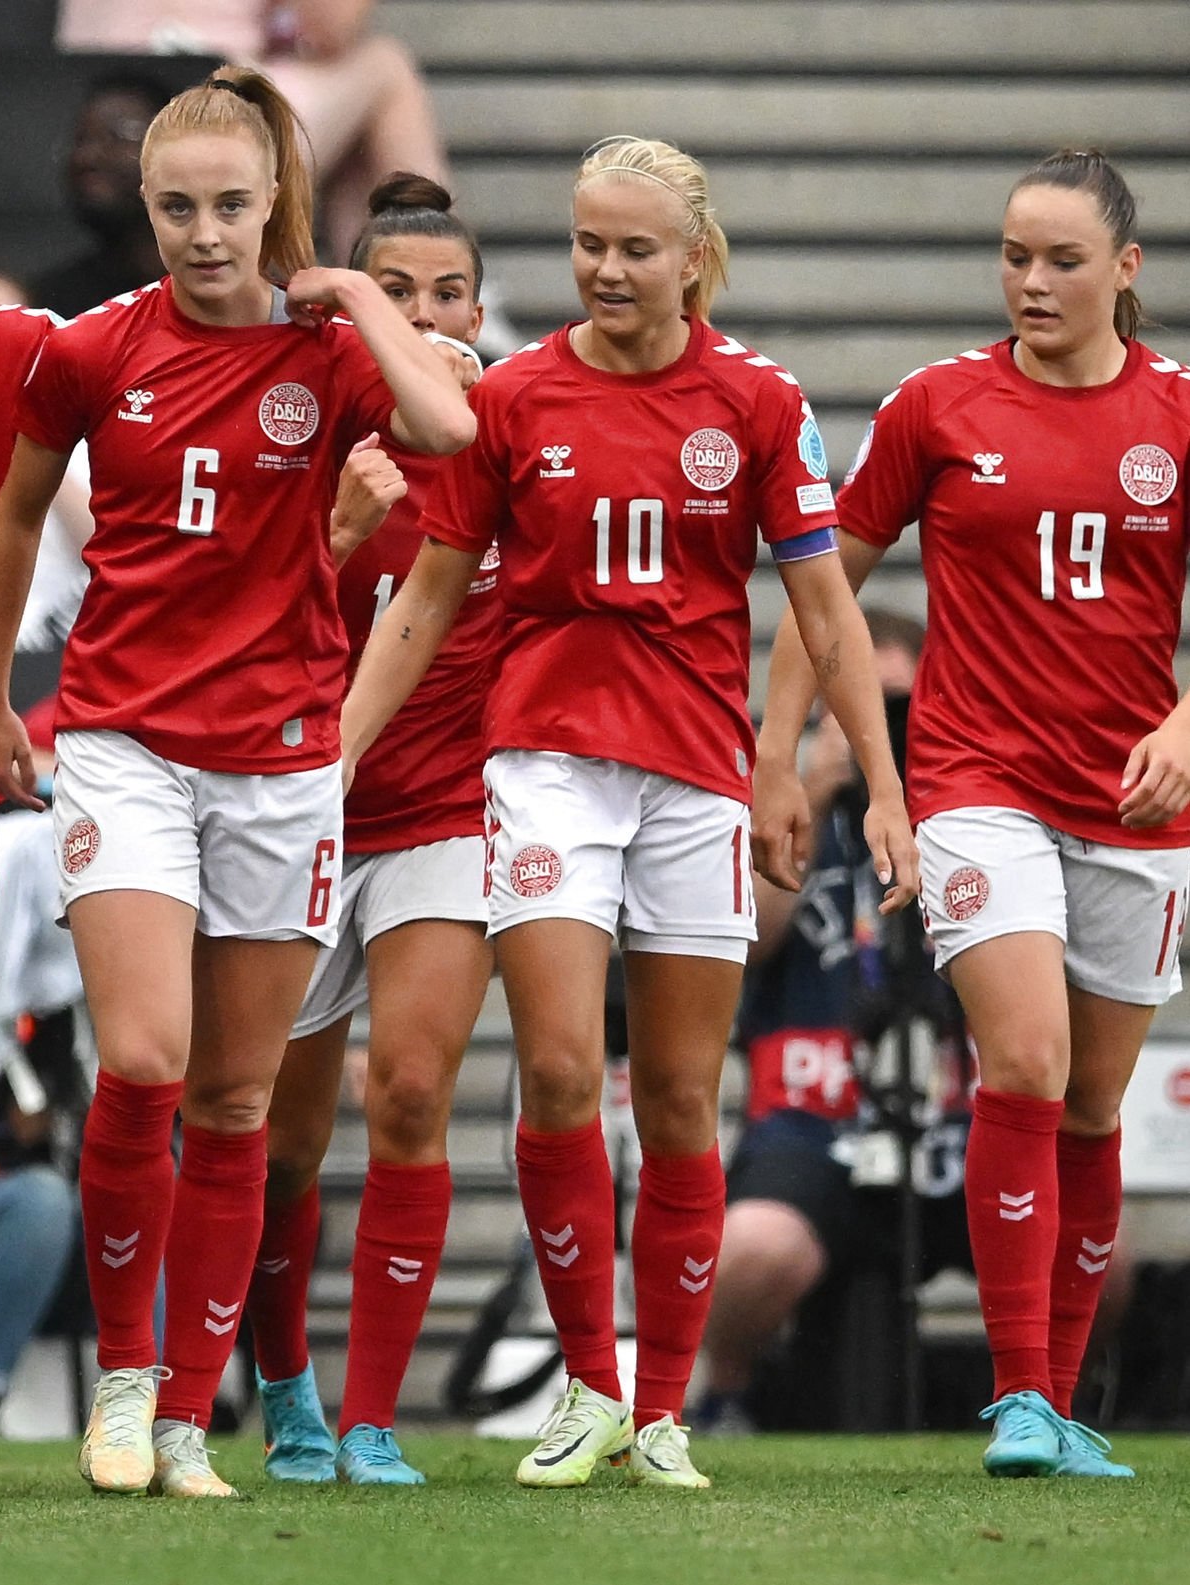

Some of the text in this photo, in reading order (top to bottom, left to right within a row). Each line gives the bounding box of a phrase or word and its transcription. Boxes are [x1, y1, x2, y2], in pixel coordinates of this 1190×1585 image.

[118, 409, 153, 423] hummel
[273, 403, 306, 422] DBU
[695, 449, 725, 467] DBU
[540, 467, 575, 478] hummel
[972, 472, 1006, 484] hummel
[1133, 464, 1164, 483] DBU
[177, 447, 220, 537] 6
[592, 497, 663, 584] 10
[1036, 511, 1106, 600] 19
[68, 833, 91, 857] DBU
[519, 861, 550, 881] DBU
[731, 825, 747, 915] 1
[306, 838, 335, 927] 6
[950, 881, 978, 906] DBU
[1155, 889, 1180, 977] 1
